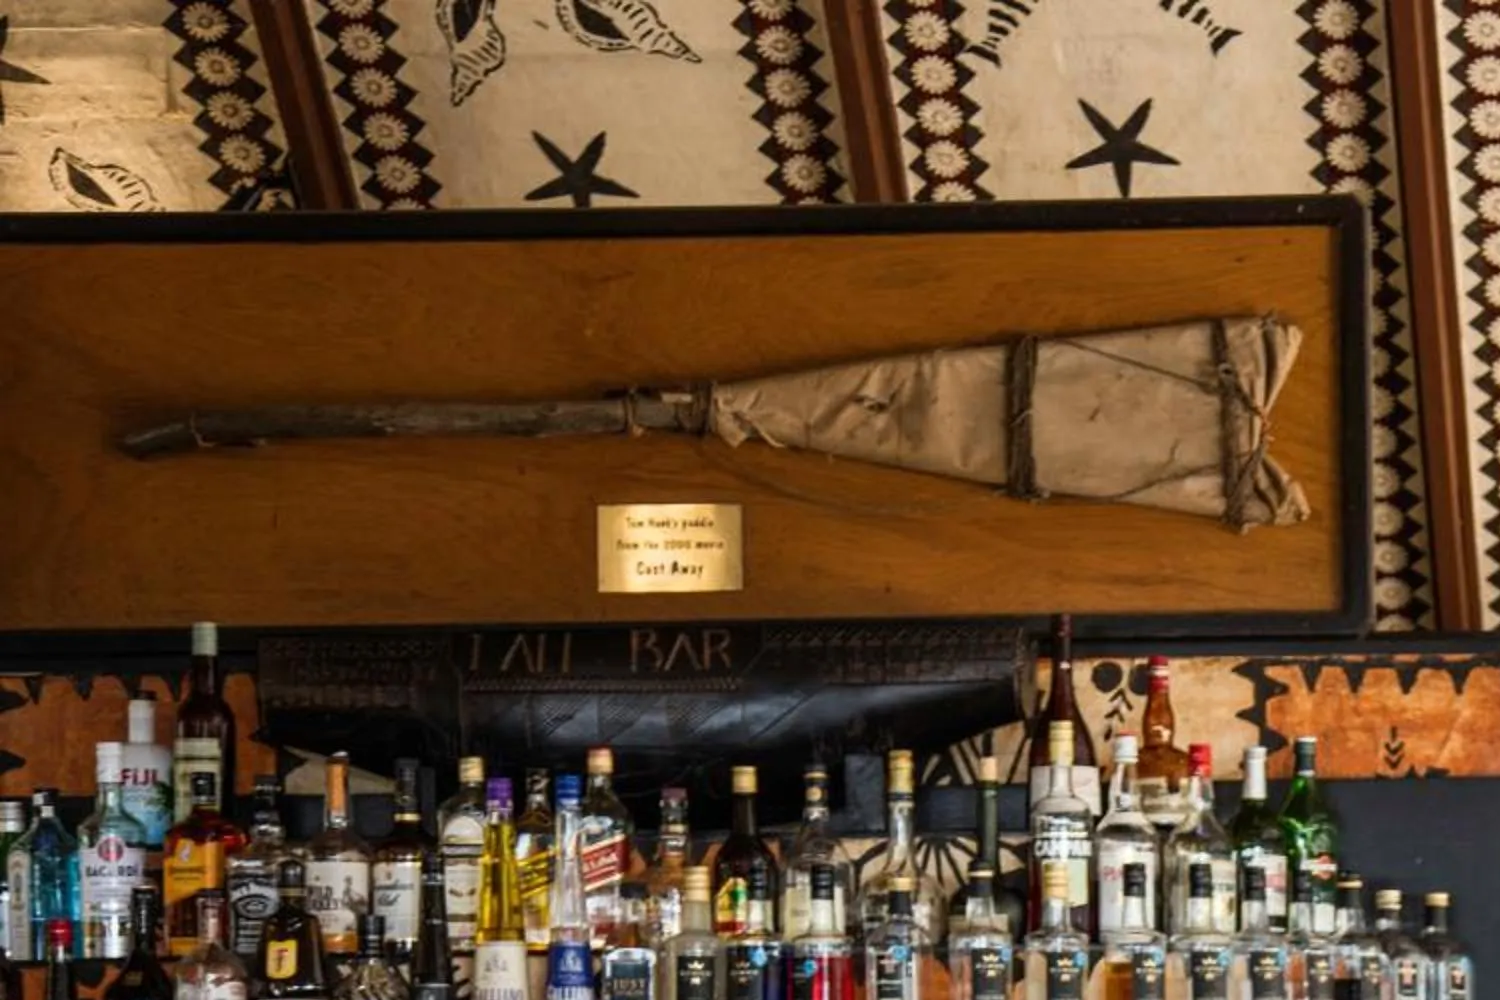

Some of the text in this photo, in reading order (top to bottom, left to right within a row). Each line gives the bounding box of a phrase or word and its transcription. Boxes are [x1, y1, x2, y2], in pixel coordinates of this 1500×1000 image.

[636, 560, 704, 579] Cast Away
[629, 628, 735, 674] BAR
